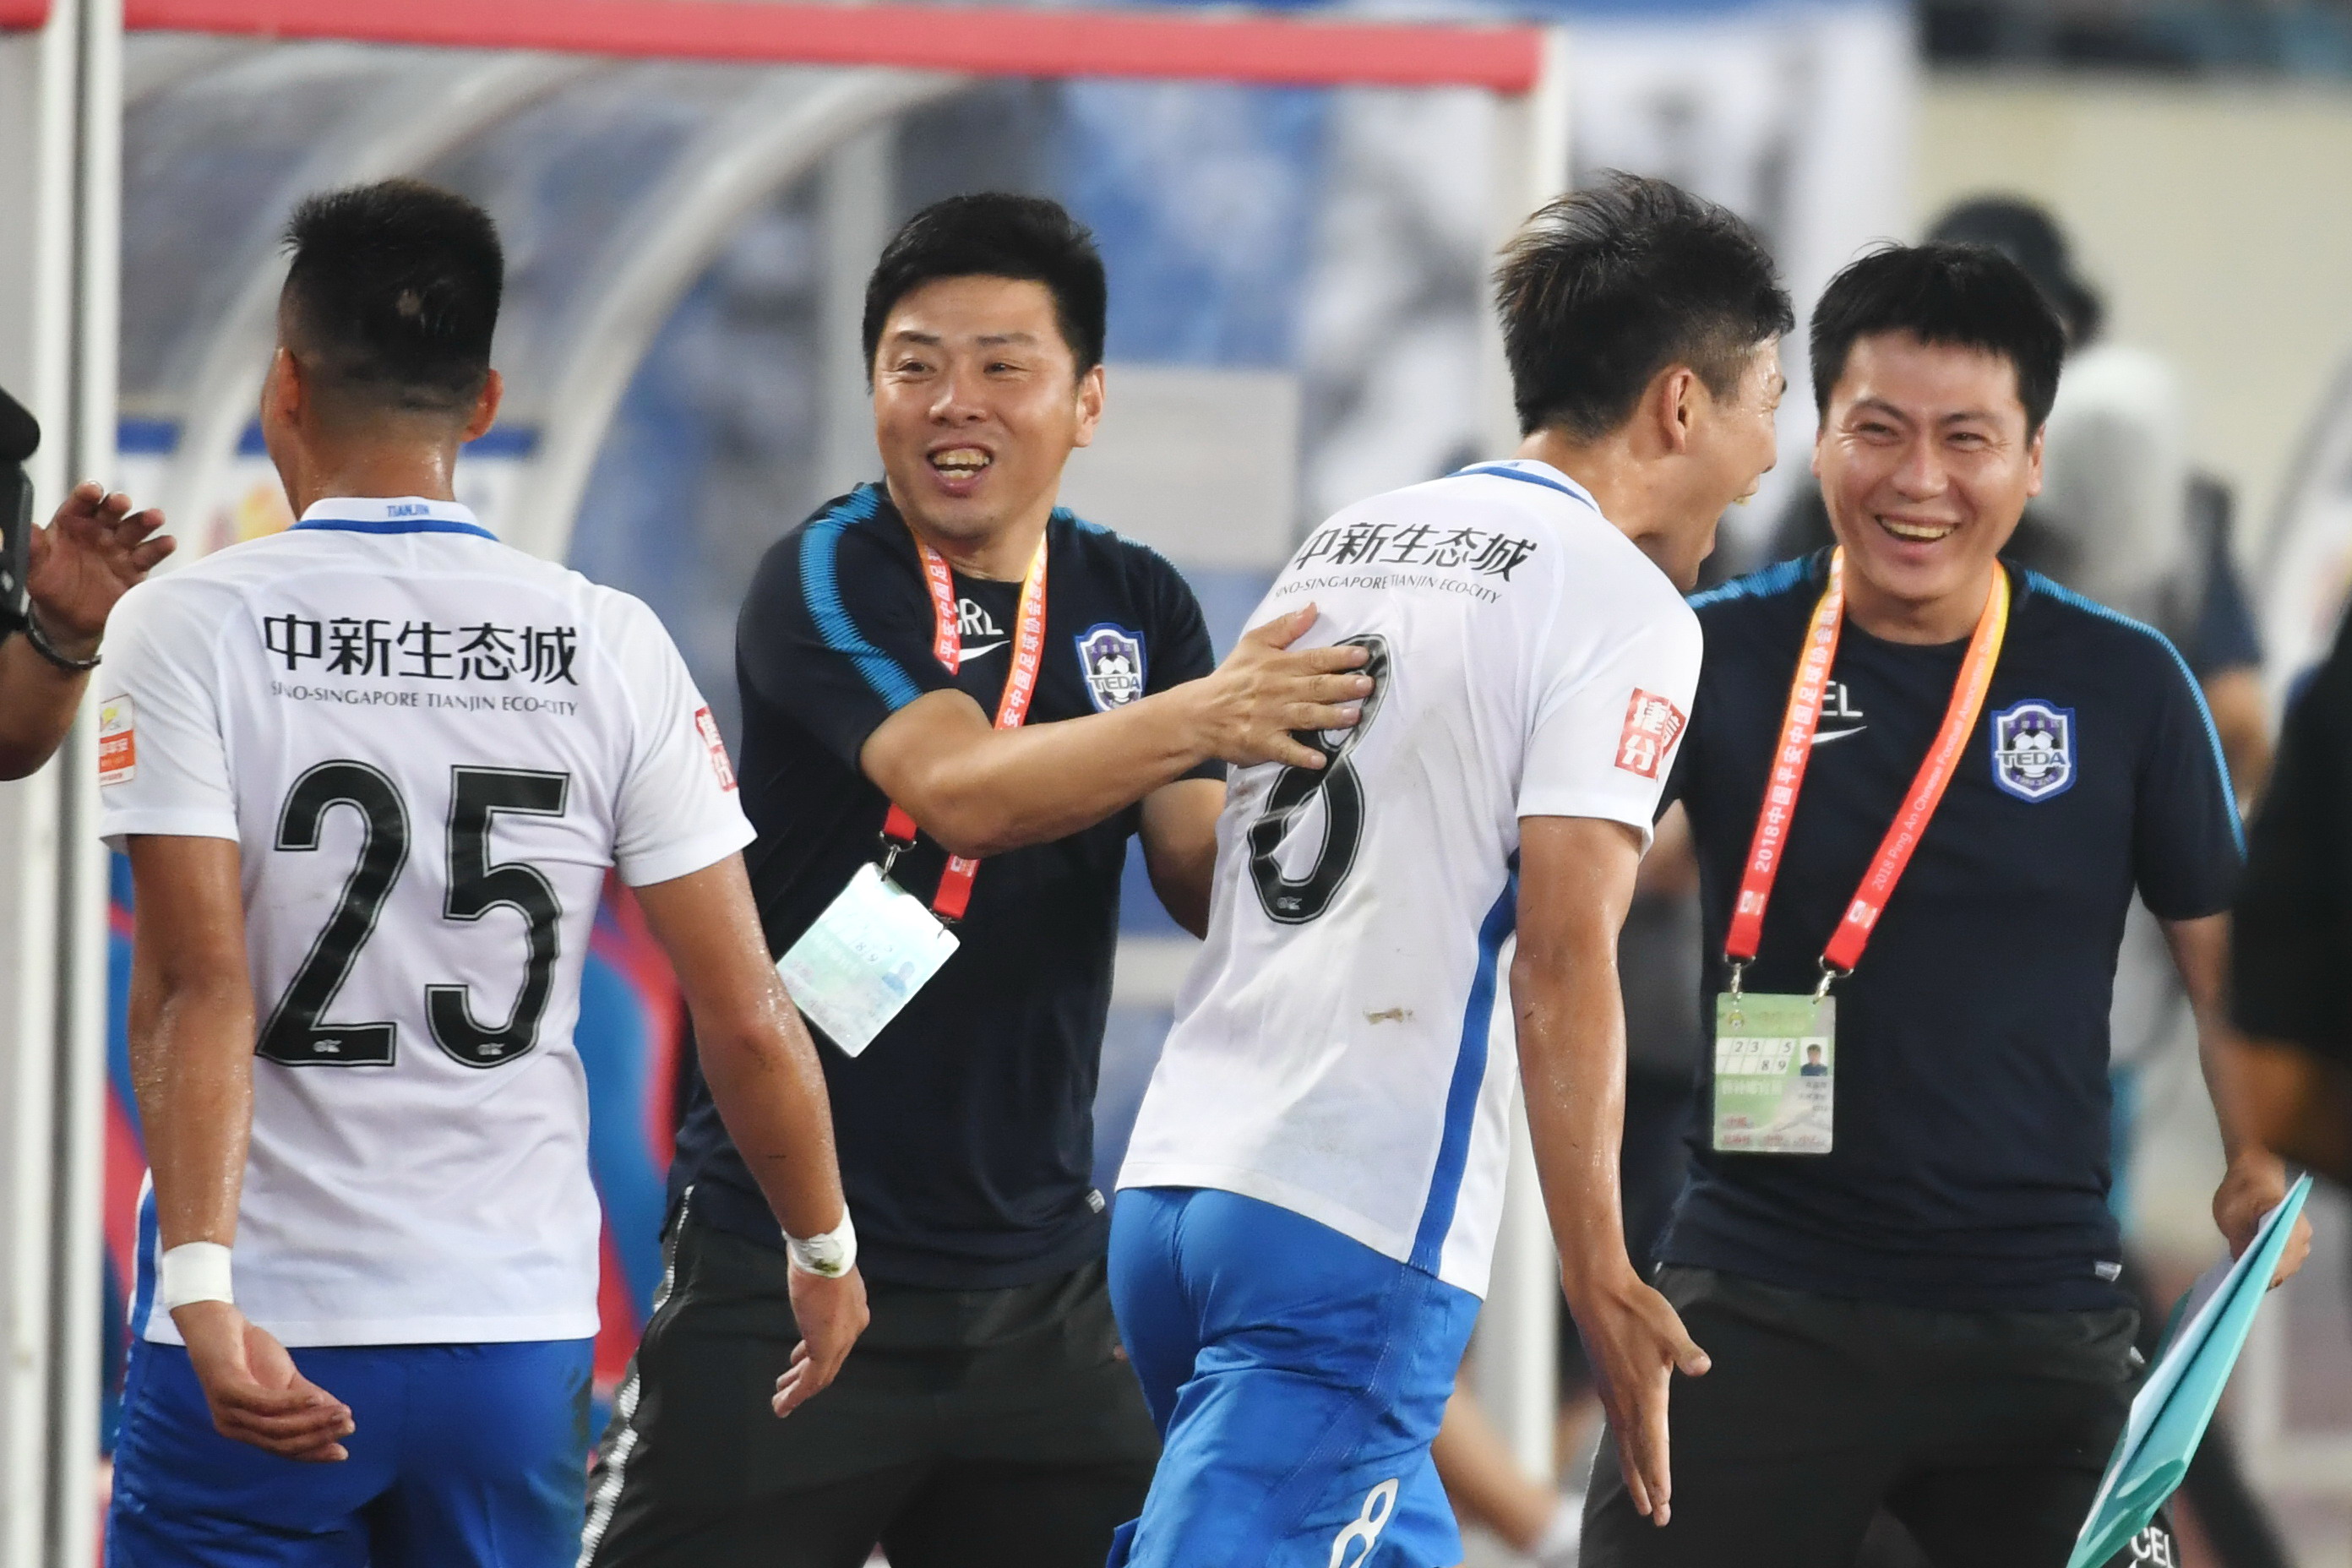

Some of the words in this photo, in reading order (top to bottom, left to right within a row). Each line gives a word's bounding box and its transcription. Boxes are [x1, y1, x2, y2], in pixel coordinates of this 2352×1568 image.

[1294, 521, 1538, 582] 中新生态城
[1390, 574, 1437, 590] TIANJIN
[1440, 579, 1503, 604] ECO-CITY
[264, 614, 579, 686] 中新生态城
[270, 681, 419, 707] SINO-SINGAPORE
[427, 693, 496, 711] TIANJIN
[502, 696, 579, 716] ECO-CITY
[1089, 675, 1141, 691] TEDA
[1997, 751, 2067, 767] TEDA
[1872, 860, 1895, 891] 2018
[1889, 831, 1913, 860] Ping
[1903, 814, 1920, 831] An
[1913, 766, 1943, 812] Chinese
[255, 760, 569, 1067] 25
[1734, 1040, 1744, 1054] 2
[1750, 1040, 1760, 1054] 3
[1783, 1040, 1792, 1054] 5
[1761, 1059, 1770, 1071] 8
[1778, 1059, 1787, 1071] 9
[1329, 1477, 1399, 1568] 8
